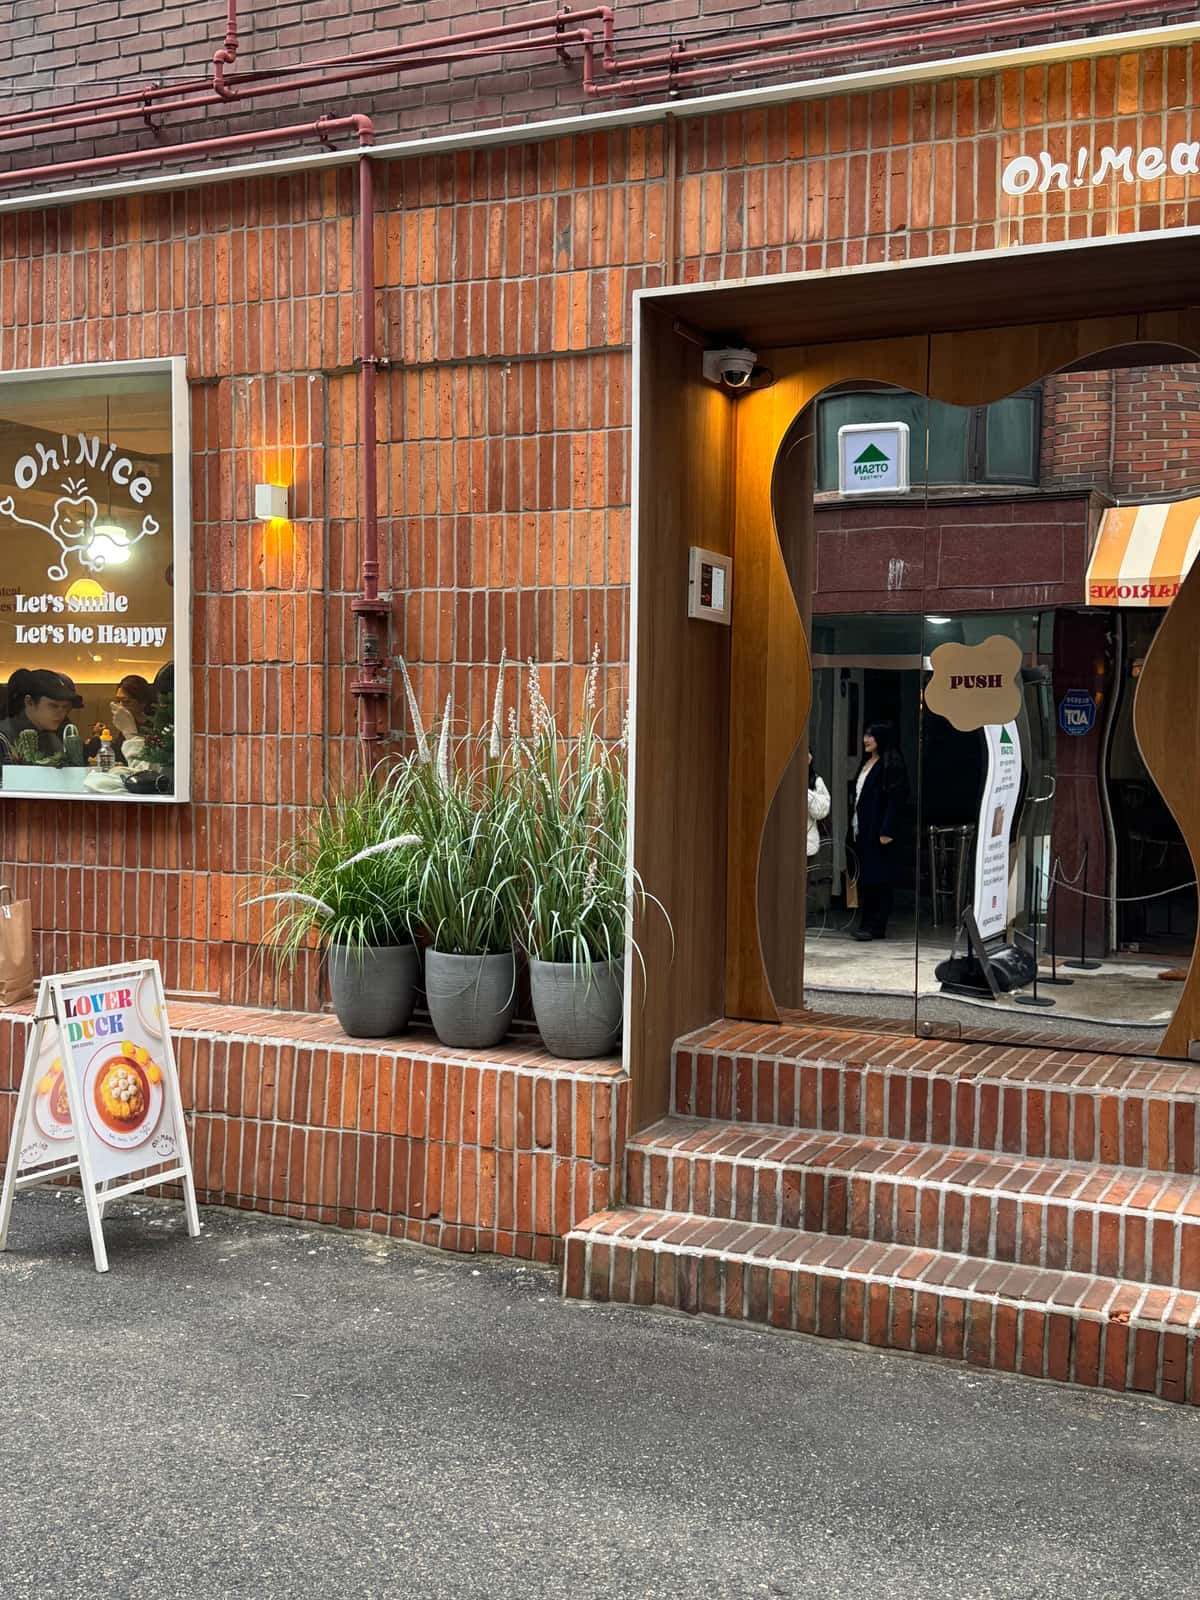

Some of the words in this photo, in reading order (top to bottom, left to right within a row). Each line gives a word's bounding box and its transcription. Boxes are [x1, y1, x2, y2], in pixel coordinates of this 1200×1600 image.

[15, 592, 64, 613] Let's
[15, 625, 64, 644] Let's
[67, 624, 94, 644] be
[97, 625, 168, 647] Happy
[950, 674, 1002, 690] PUSH
[64, 988, 133, 1018] LOVER
[67, 1013, 124, 1042] DUCK
